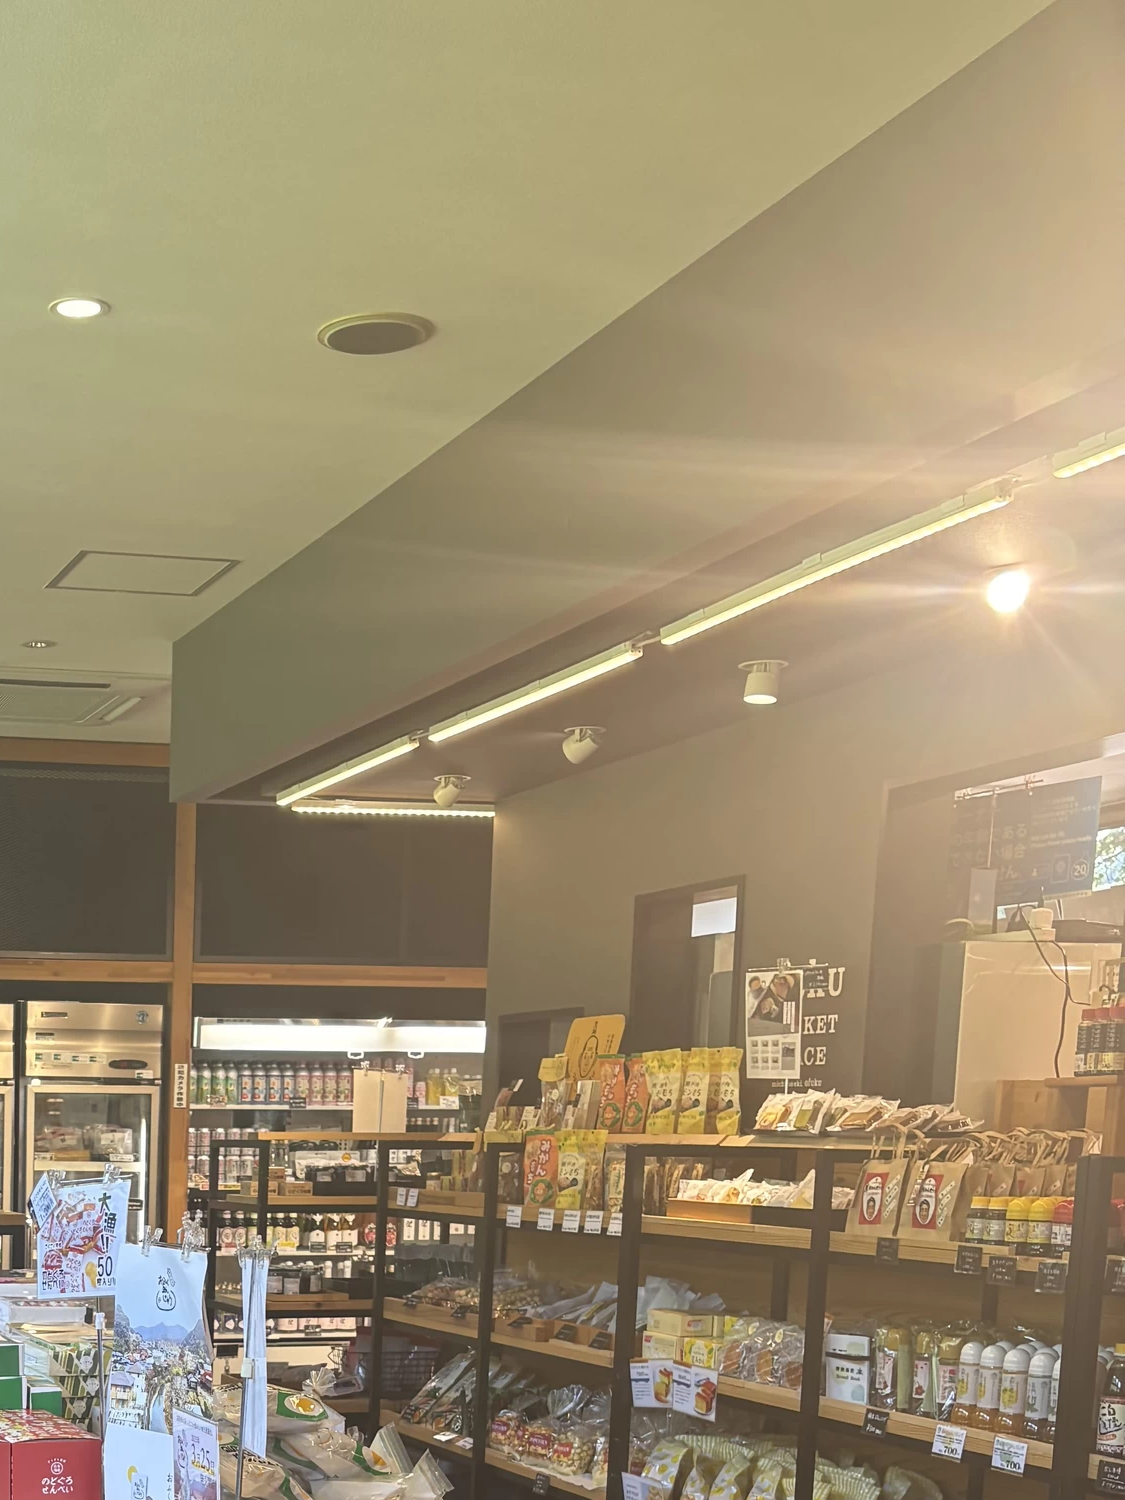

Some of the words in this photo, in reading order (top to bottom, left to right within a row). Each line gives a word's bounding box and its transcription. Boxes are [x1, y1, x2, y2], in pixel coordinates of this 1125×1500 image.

[1073, 864, 1087, 876] 20
[803, 1014, 838, 1034] KET
[801, 1046, 826, 1066] CE
[536, 1140, 551, 1176] みかん
[97, 1256, 113, 1277] 50
[943, 1446, 958, 1456] 700
[1006, 1460, 1021, 1471] 700
[41, 1476, 73, 1486] のどぐろ
[42, 1485, 74, 1495] せんべい
